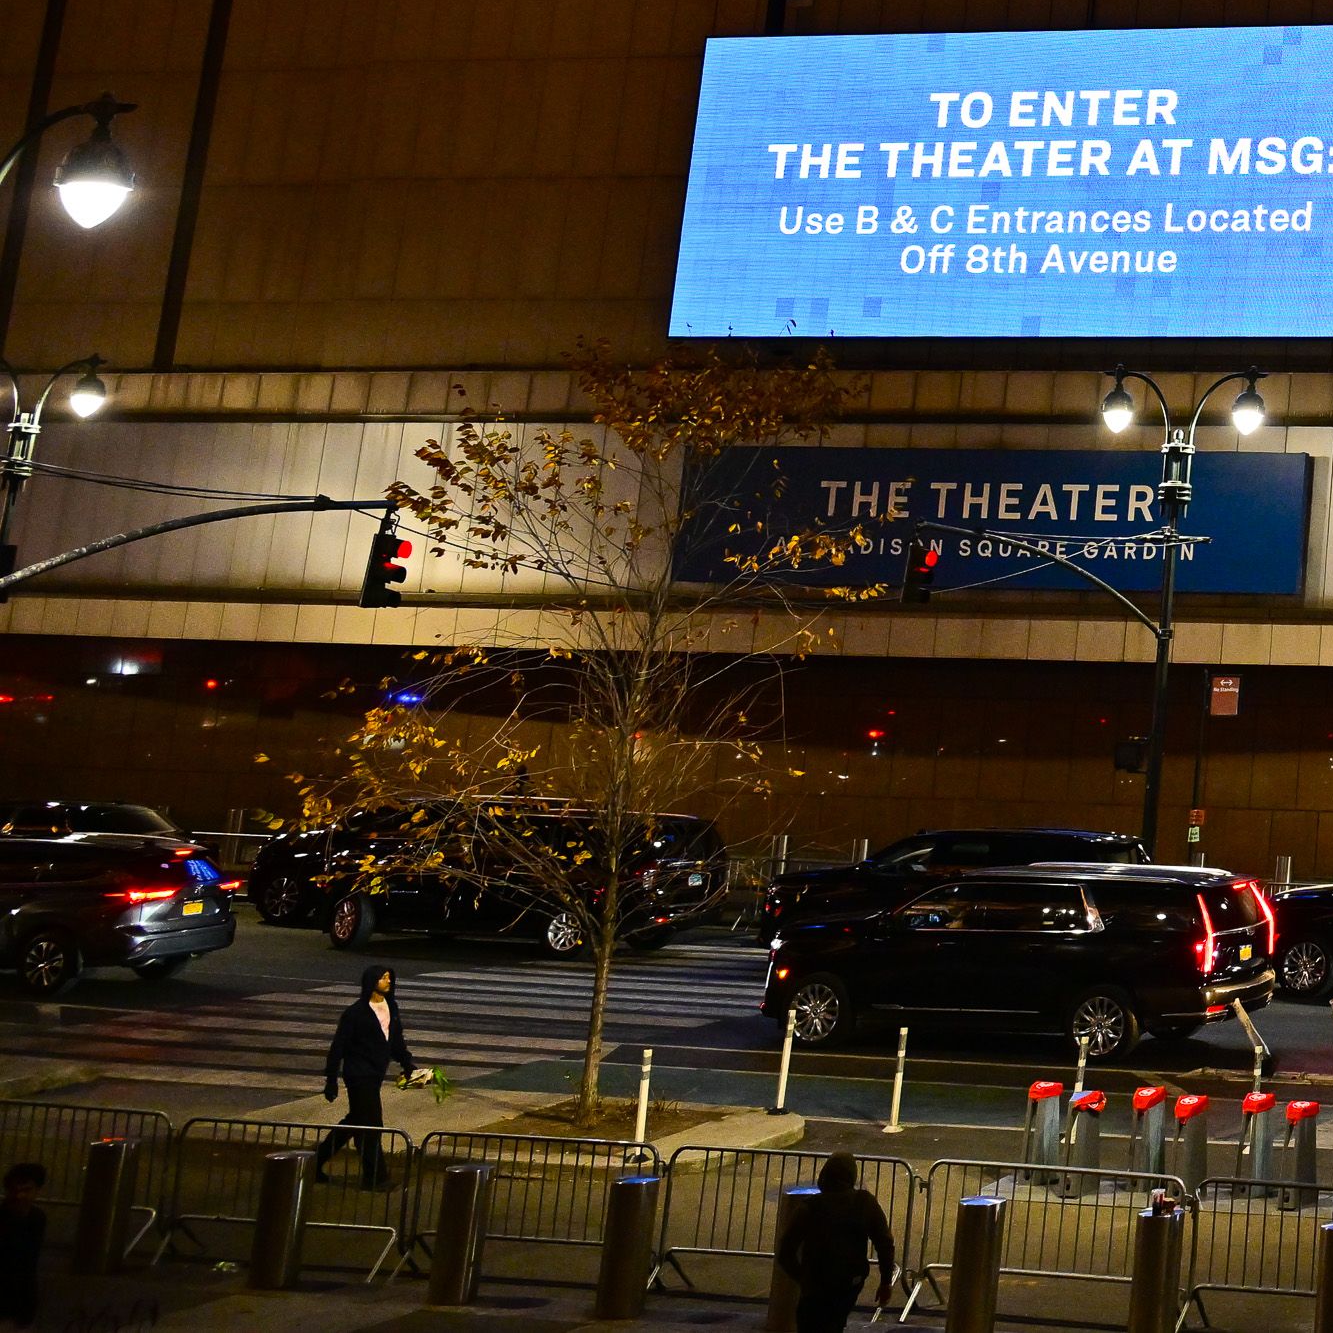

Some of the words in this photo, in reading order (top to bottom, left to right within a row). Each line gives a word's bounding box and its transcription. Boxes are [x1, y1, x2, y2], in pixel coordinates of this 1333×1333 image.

[929, 90, 994, 129] TO
[1008, 88, 1179, 128] ENTER
[767, 142, 866, 180] THE
[878, 138, 1113, 178] THEATER
[1125, 138, 1194, 177] AT
[778, 205, 845, 236] Use
[855, 204, 880, 235] B
[889, 204, 919, 235] &
[929, 204, 955, 234] C
[966, 203, 1152, 235] Entrances
[1163, 200, 1314, 233] Located
[899, 243, 954, 275] Off
[964, 242, 1028, 275] 8th
[1039, 243, 1178, 274] Avenue
[820, 479, 912, 519] THE
[929, 481, 1155, 523] THEATER
[816, 537, 944, 557] DISN
